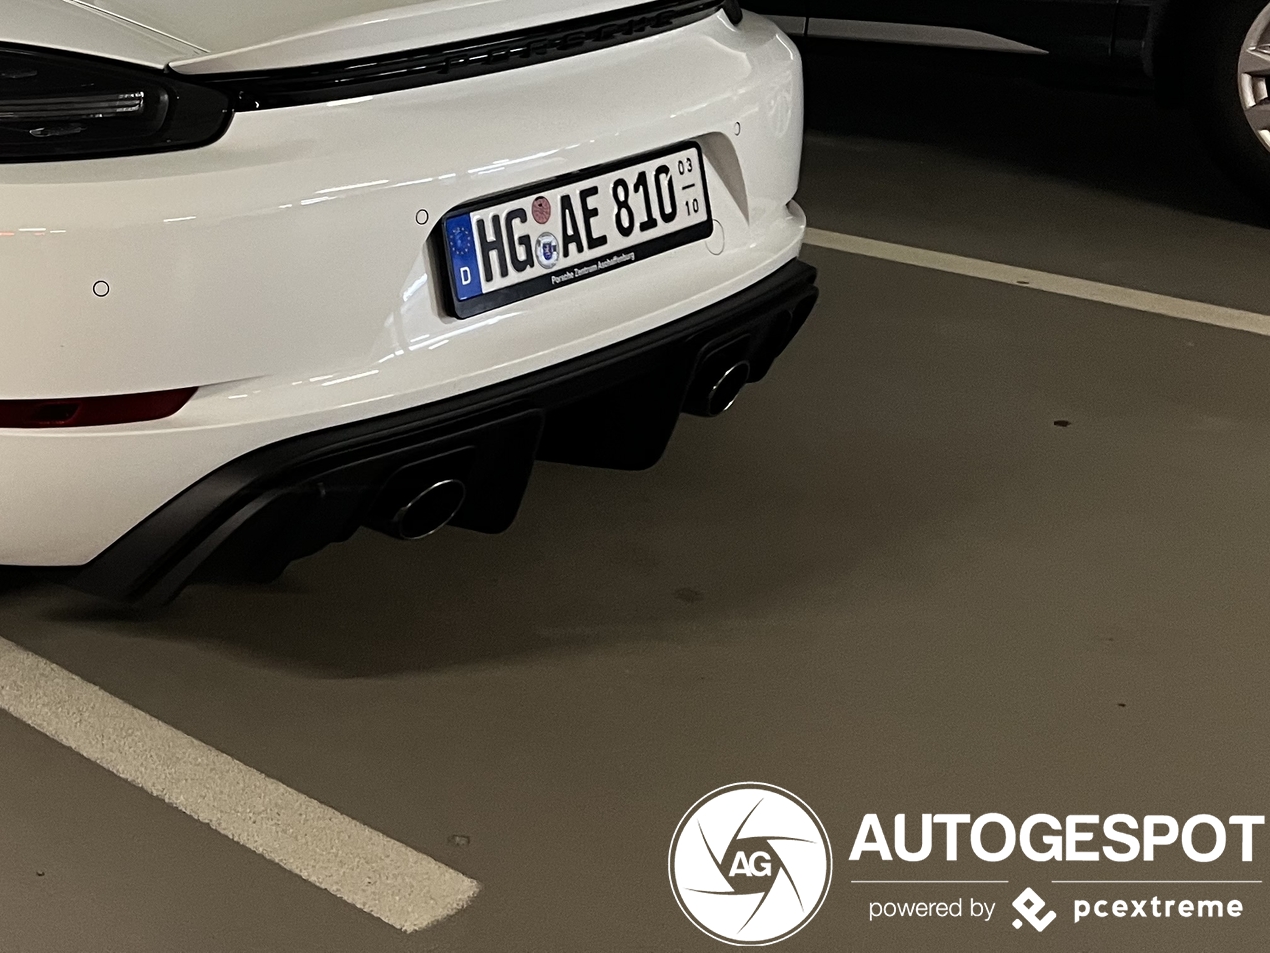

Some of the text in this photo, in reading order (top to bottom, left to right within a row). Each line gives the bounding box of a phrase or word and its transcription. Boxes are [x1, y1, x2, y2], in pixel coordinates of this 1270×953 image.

[678, 157, 693, 176] 03
[685, 198, 699, 216] 10
[476, 164, 678, 283] HG AE 810
[460, 266, 472, 286] D
[551, 271, 574, 285] Porsche
[574, 264, 597, 277] Zentrum
